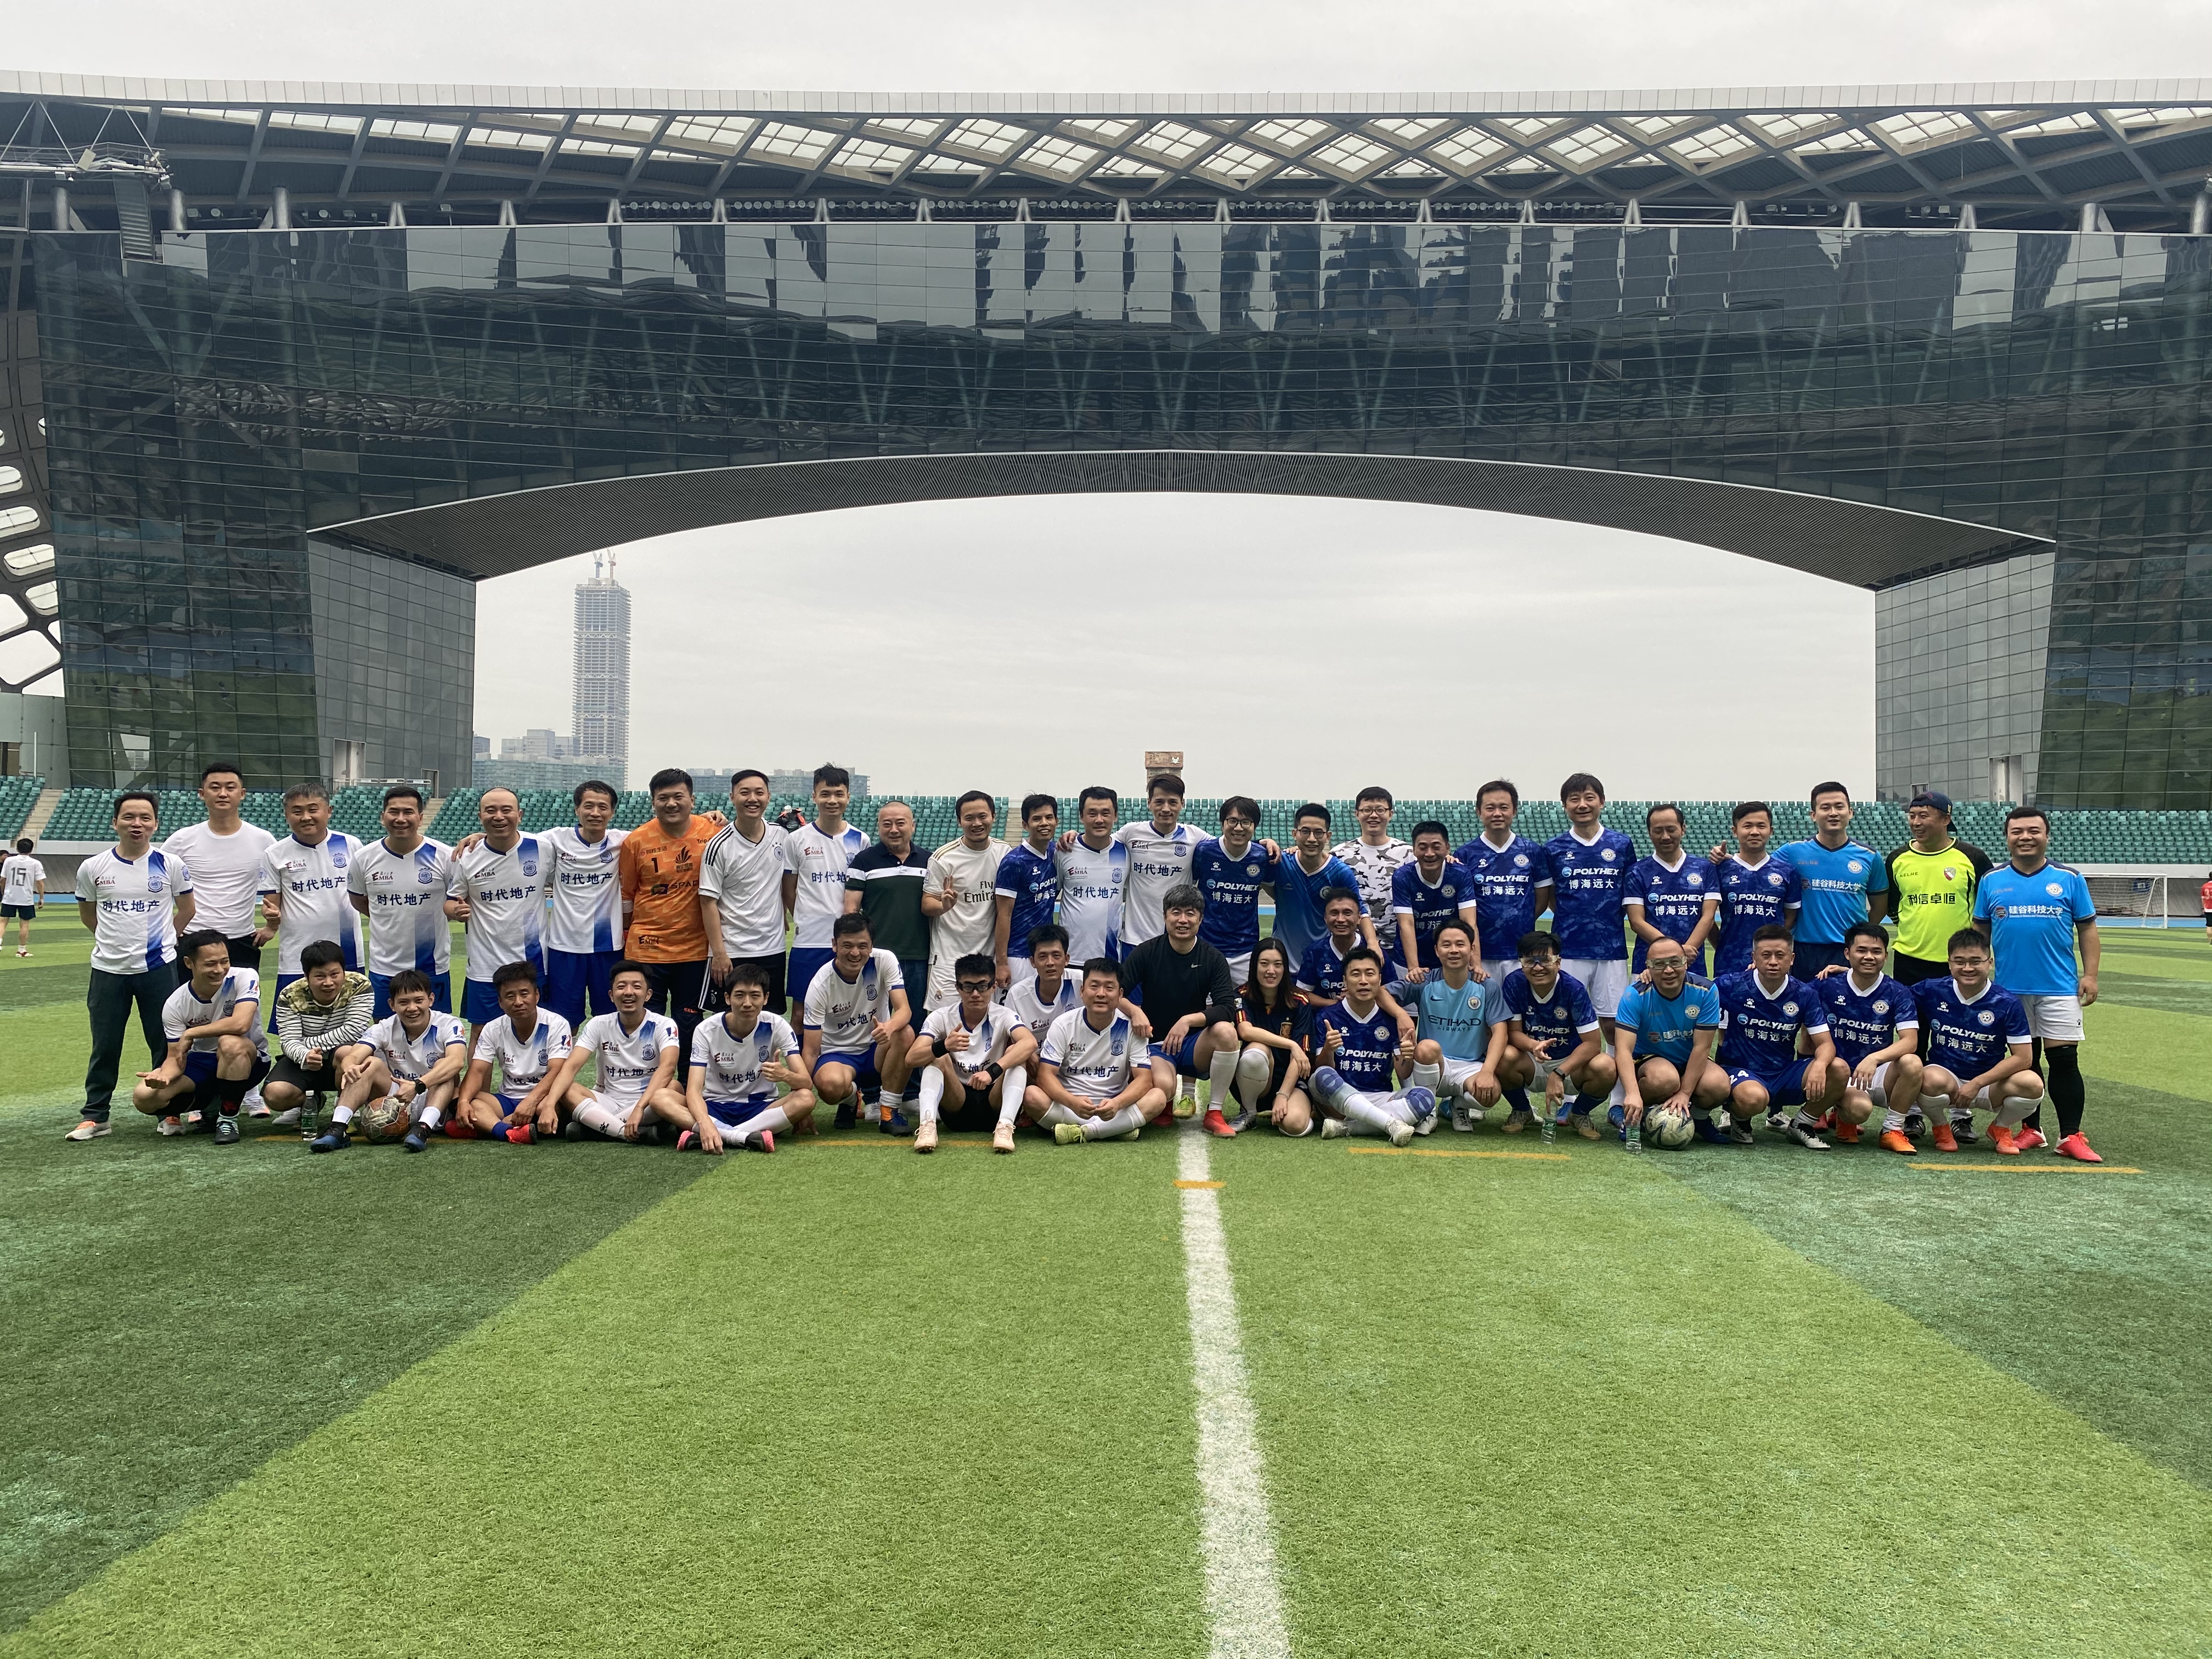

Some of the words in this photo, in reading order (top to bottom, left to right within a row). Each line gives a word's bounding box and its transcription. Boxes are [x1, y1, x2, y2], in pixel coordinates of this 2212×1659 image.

[804, 847, 823, 856] EMBA
[651, 857, 658, 873] 1
[1134, 862, 1182, 876] 时代地产
[11, 867, 26, 886] 15
[372, 871, 393, 881] EMBA
[812, 871, 845, 883] 时代地
[1068, 867, 1087, 876] EMBA
[95, 877, 115, 887] EMBA
[292, 876, 345, 892] 时代地产
[561, 872, 613, 884] 时代地产
[1040, 877, 1057, 889] POLYH
[1569, 879, 1614, 889] 博海远大
[670, 880, 699, 889] SPAC
[980, 881, 994, 889] Fly
[1216, 882, 1259, 891] POLYHEX
[1812, 879, 1860, 891] 硅谷科技大学
[481, 885, 535, 901] 时代地产
[964, 890, 995, 902] Emira
[1073, 887, 1119, 899] 时代地产
[1481, 886, 1525, 896] 博海远大
[377, 893, 431, 905] 时代地产
[1212, 891, 1252, 904] 博海远大
[1738, 894, 1781, 904] POLYHEX
[103, 900, 160, 912] 时代地产
[1655, 905, 1699, 916] 博海远大
[1734, 905, 1776, 917] 博海远大
[2009, 905, 2063, 915] 硅谷科技大学
[1428, 1015, 1481, 1026] ETIHAD
[1750, 1019, 1798, 1030] POLYHEX
[1838, 1018, 1889, 1031] POLYHEX
[1531, 1025, 1570, 1034] POLYHEX
[1745, 1028, 1791, 1042] 博海远大
[1941, 1025, 1996, 1041] POLYHEX
[1834, 1027, 1883, 1045] 博海远大
[602, 1042, 619, 1050] EMB
[1937, 1034, 1987, 1053] 博海远大
[714, 1052, 734, 1062] EMBA
[1345, 1049, 1389, 1059] POLYHEX
[1067, 1066, 1119, 1077] 时代地产
[1340, 1060, 1382, 1071] 博海远大
[1729, 1070, 1749, 1084] 24
